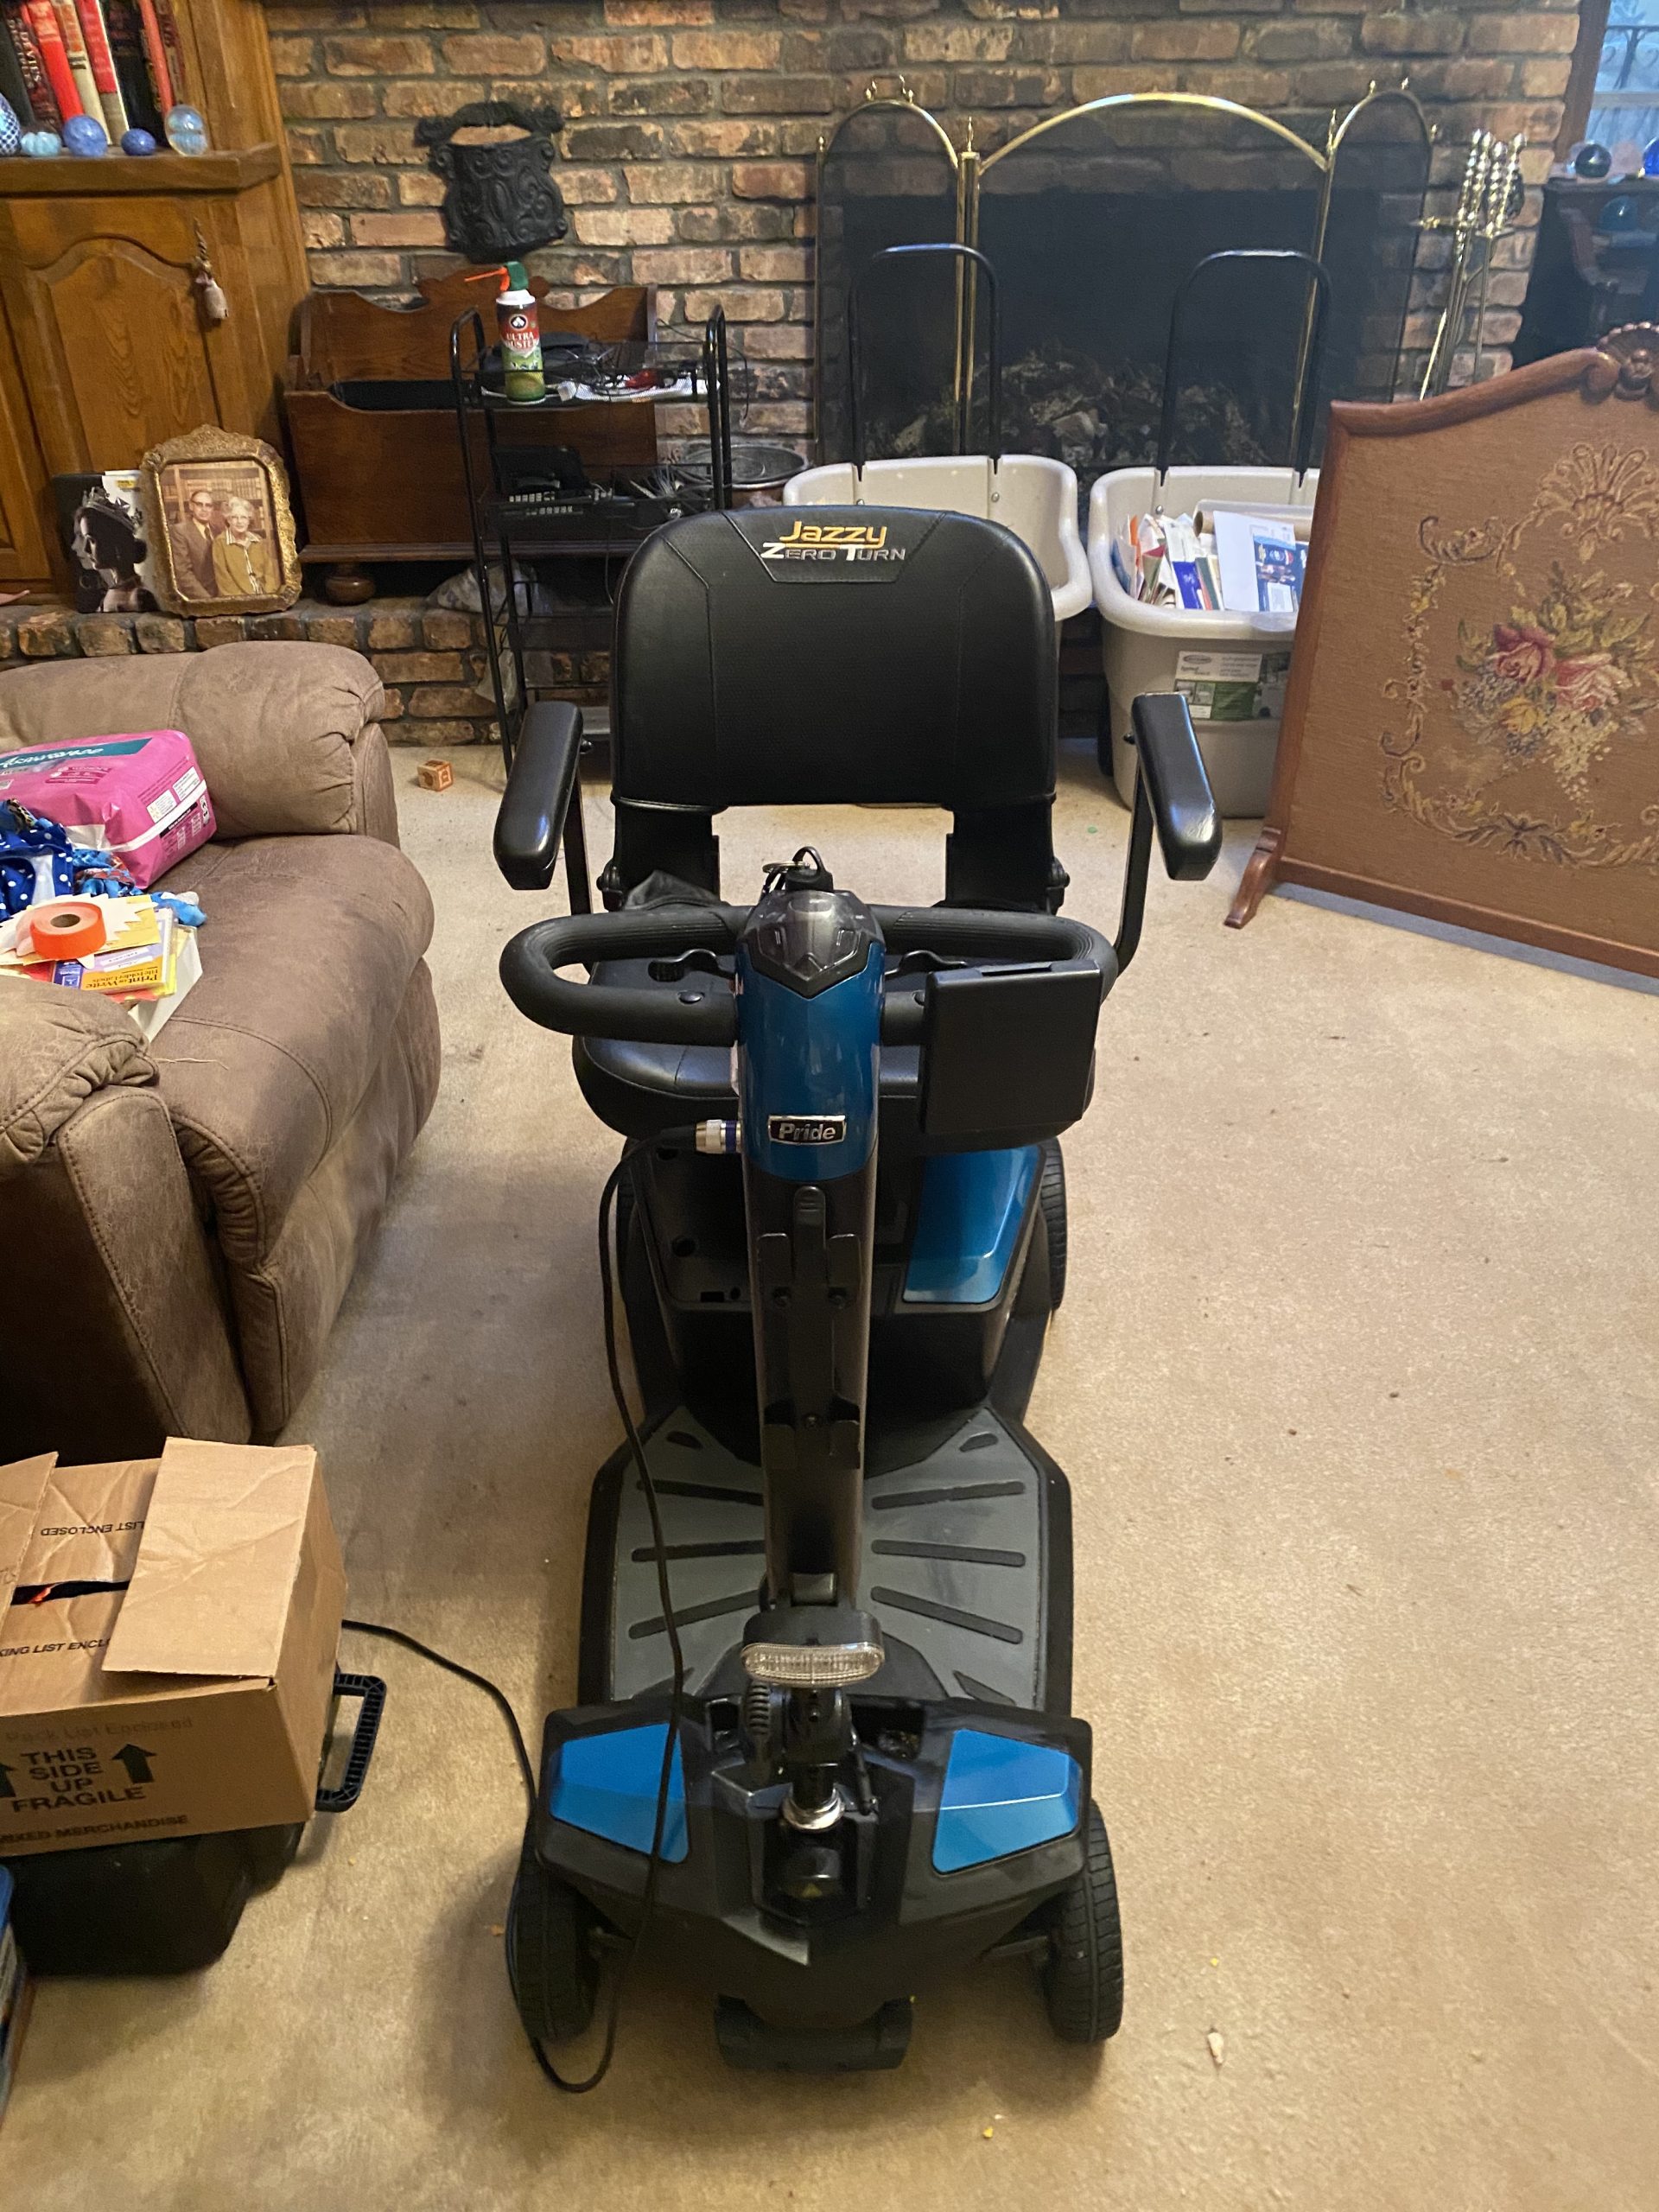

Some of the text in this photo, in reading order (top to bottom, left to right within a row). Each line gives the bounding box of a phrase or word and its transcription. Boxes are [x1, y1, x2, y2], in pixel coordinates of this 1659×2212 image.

[506, 332, 534, 340] ULTRA
[779, 520, 887, 549] Jazzy
[760, 542, 906, 562] ZERO TURN
[129, 974, 157, 983] Print
[779, 1122, 836, 1141] Pride
[40, 1521, 145, 1536] LIST ENCLOSED
[33, 1643, 66, 1654] LIST
[21, 1746, 97, 1765] THIS
[29, 1761, 104, 1780] SIDE
[51, 1777, 93, 1793] UP
[13, 1786, 147, 1813] FRAGILE
[55, 1815, 189, 1838] MERCHANDISE
